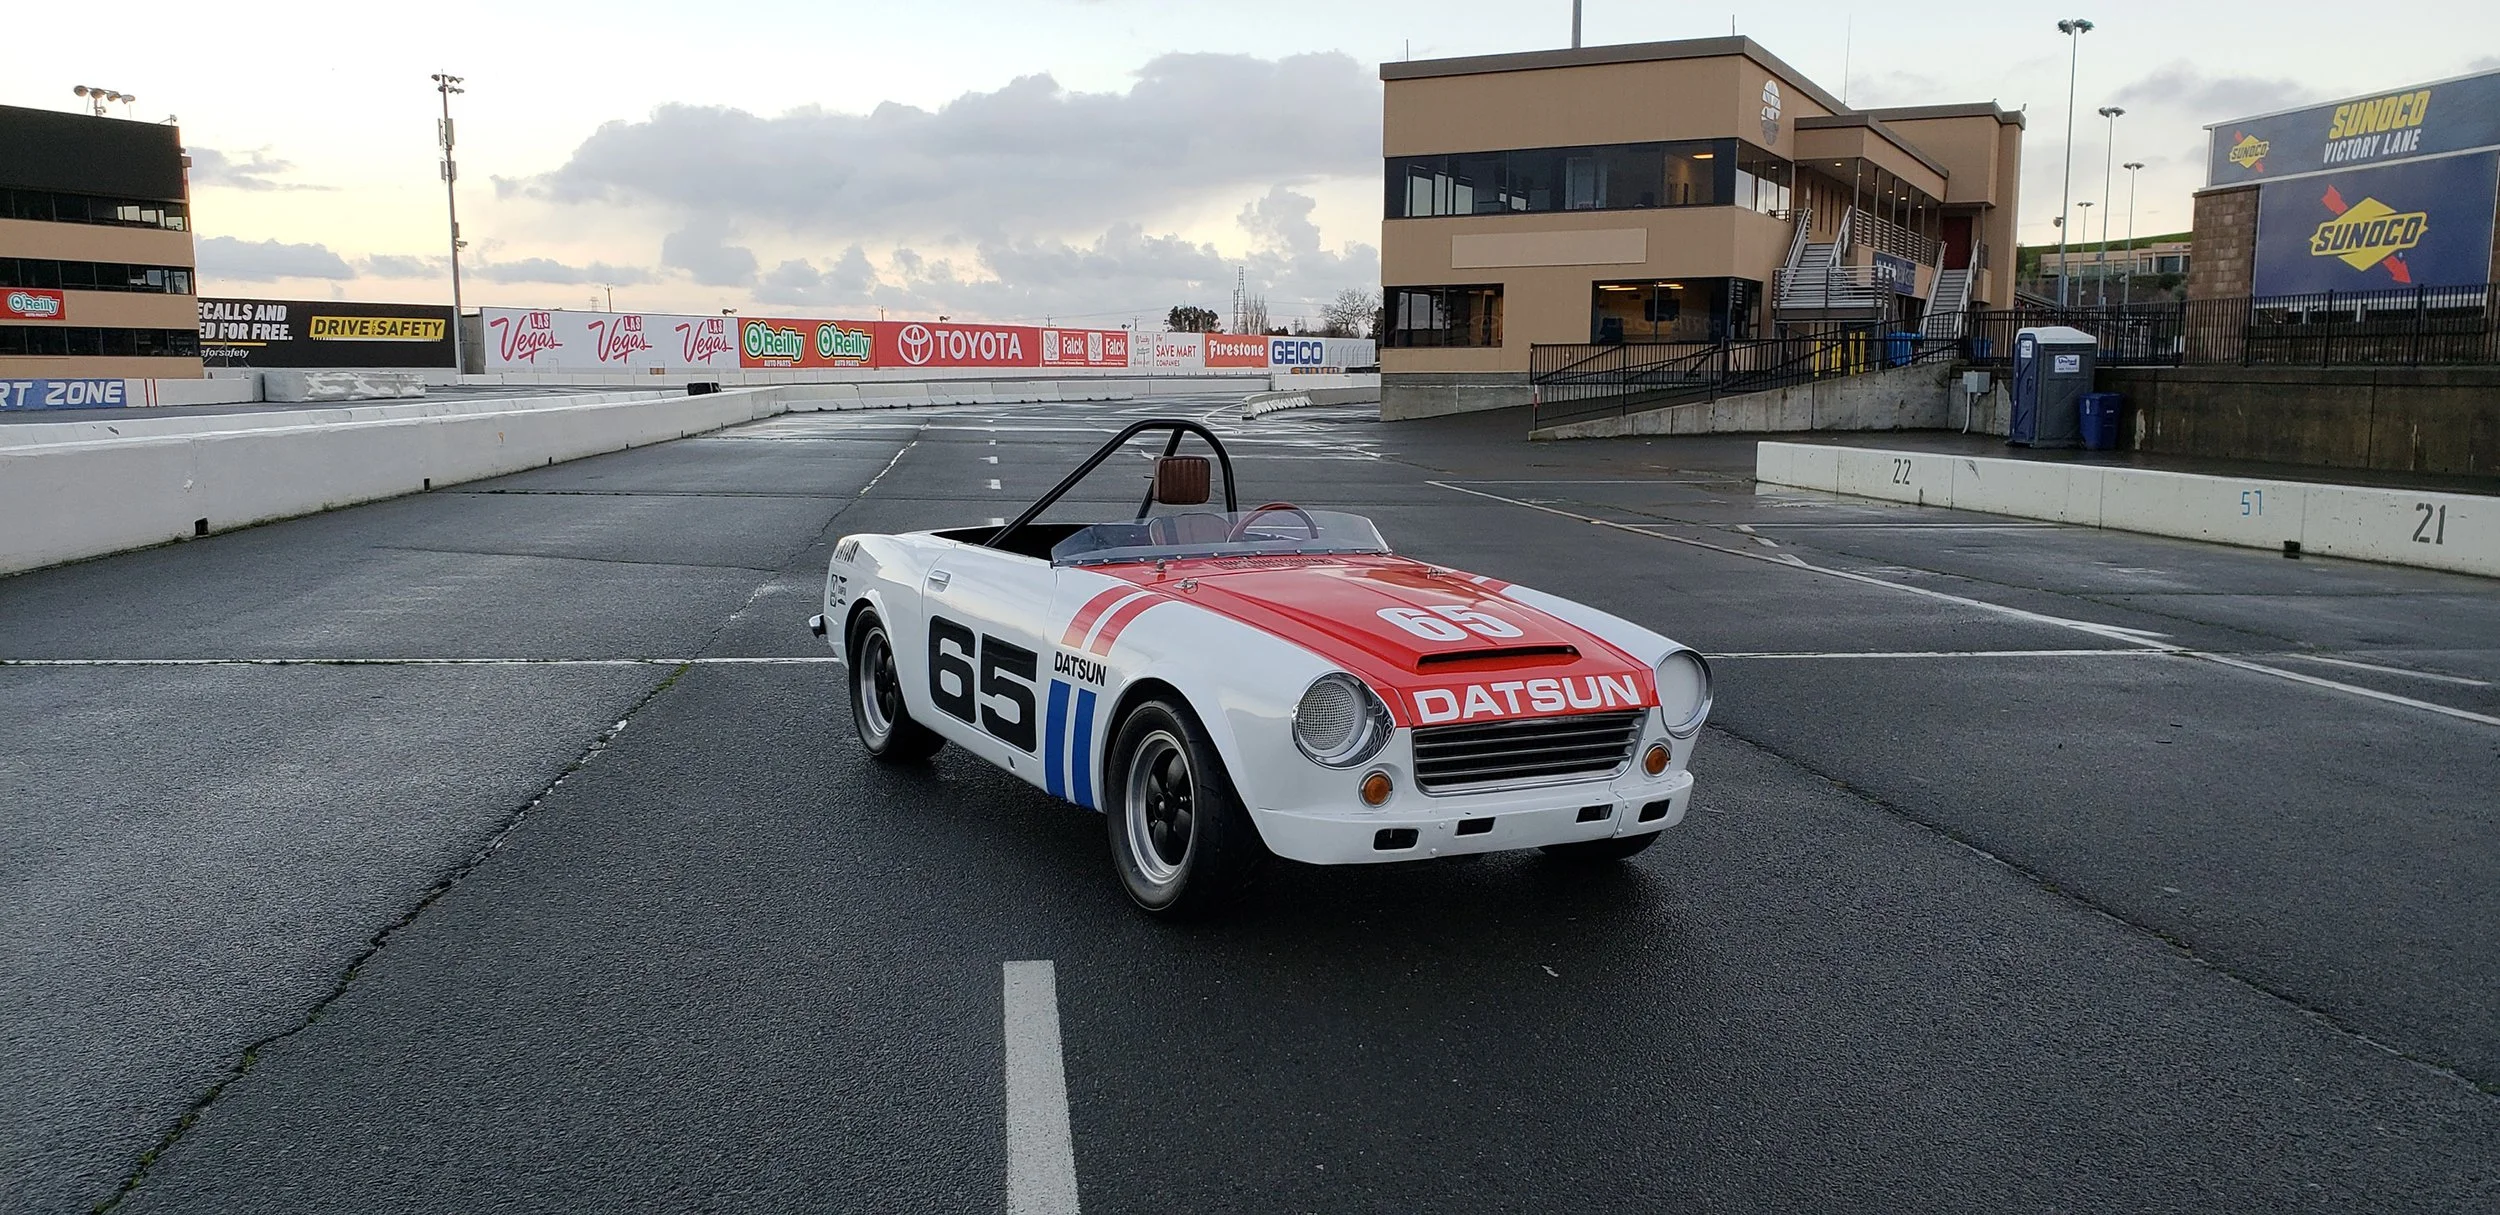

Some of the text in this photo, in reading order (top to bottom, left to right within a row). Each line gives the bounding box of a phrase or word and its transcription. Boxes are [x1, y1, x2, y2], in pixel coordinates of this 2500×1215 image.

[2329, 90, 2431, 139] SUNOCO
[2231, 143, 2268, 160] SUNOCO
[2323, 128, 2422, 163] VICTORY LANE
[2314, 216, 2423, 252] SUNOCO
[9, 294, 58, 313] O'Reilly
[254, 304, 287, 321] AND
[218, 322, 249, 340] FOR
[251, 323, 293, 340] FREE.
[314, 319, 370, 335] DRIVE
[376, 320, 442, 336] SAFETY
[530, 313, 550, 329] LAS
[623, 316, 642, 332] LAS
[707, 319, 724, 334] LAS
[490, 315, 563, 364] Vegas
[588, 318, 653, 364] Vegas
[675, 321, 733, 364] Vegas
[745, 323, 803, 360] O'Reilly
[818, 323, 871, 360] O'Reilly
[935, 330, 1023, 360] TOYOTA
[1063, 337, 1084, 355] Falck
[1105, 338, 1126, 355] Falck
[1156, 345, 1175, 357] SAVE
[1176, 345, 1196, 357] MART
[1208, 339, 1264, 359] Firestone
[1272, 340, 1323, 365] GEICO
[45, 381, 123, 405] ZONE
[1892, 458, 1911, 485] 22
[2412, 502, 2447, 545] 21
[1376, 605, 1524, 642] 65
[1054, 651, 1107, 687] DATSUN
[928, 614, 1038, 753] 65
[1412, 674, 1642, 724] DATSUN
